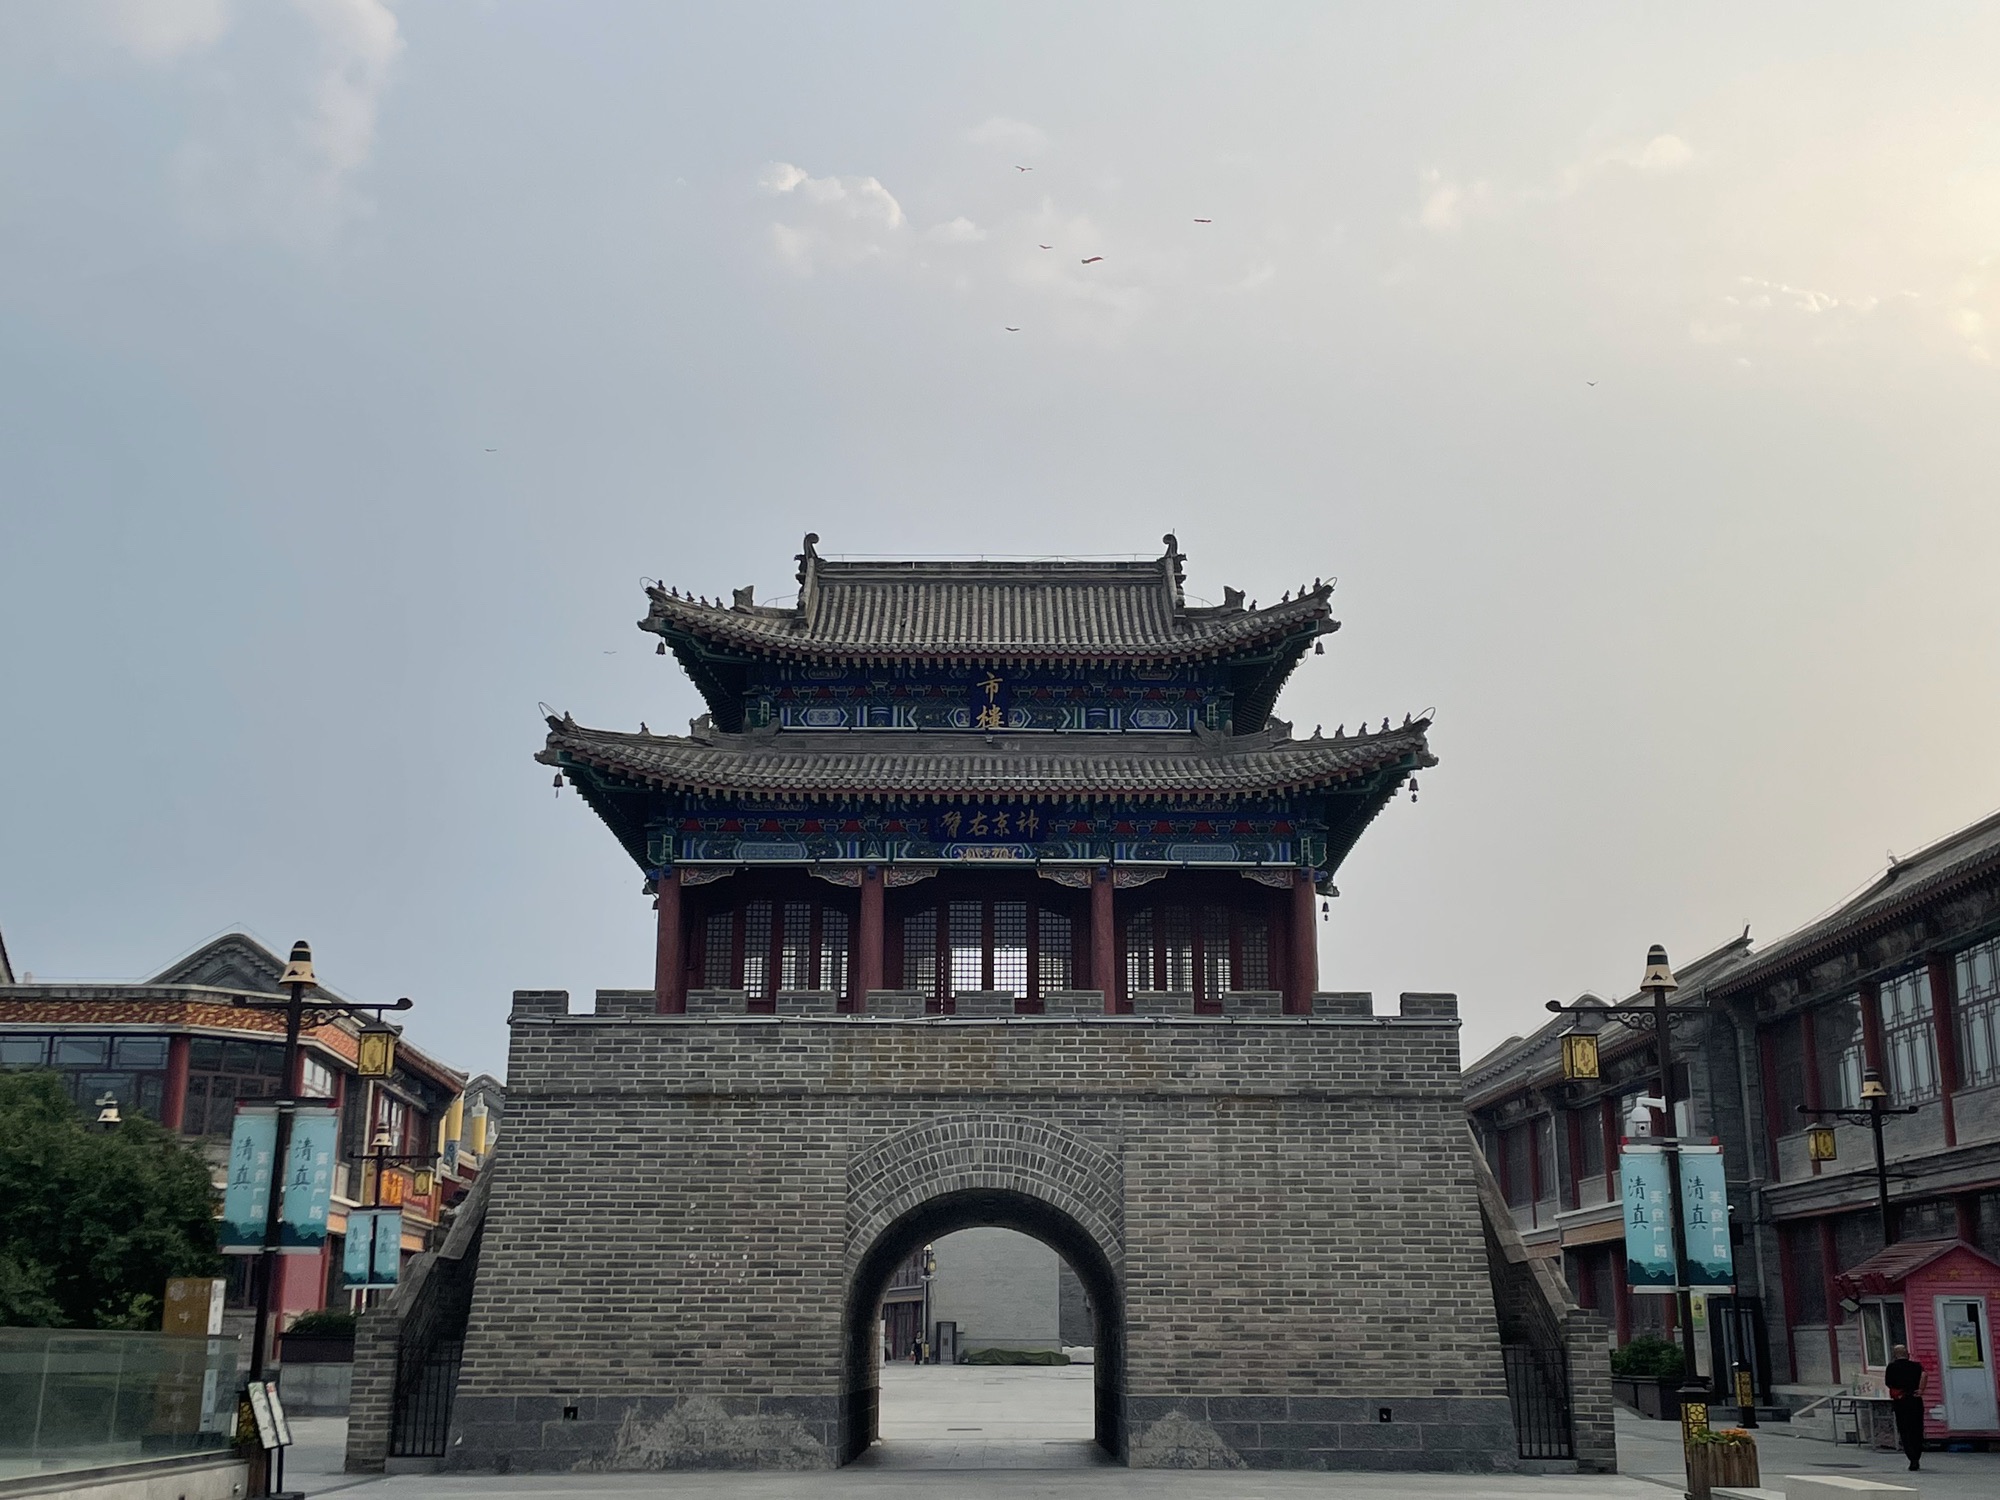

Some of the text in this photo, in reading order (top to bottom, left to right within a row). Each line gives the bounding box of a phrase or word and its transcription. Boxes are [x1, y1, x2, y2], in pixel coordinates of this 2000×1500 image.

[974, 671, 1005, 728] 市樓
[231, 1135, 256, 1191] 清真
[290, 1136, 315, 1191] 清真
[1628, 1175, 1650, 1230] 清真
[1687, 1175, 1709, 1230] 清真
